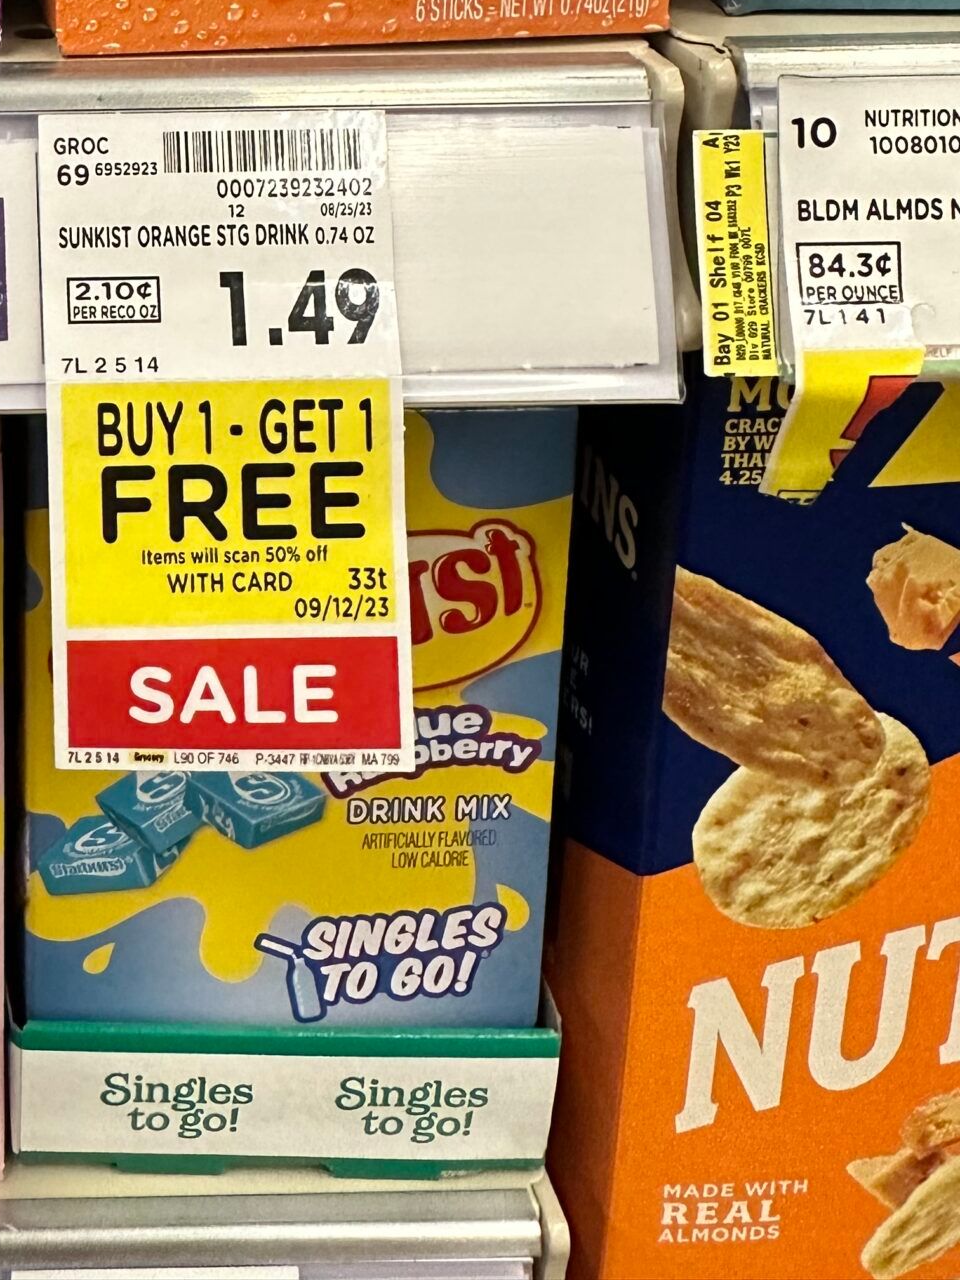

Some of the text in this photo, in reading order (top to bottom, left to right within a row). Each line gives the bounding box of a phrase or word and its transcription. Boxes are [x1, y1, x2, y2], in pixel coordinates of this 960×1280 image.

[791, 117, 837, 148] 10
[54, 137, 109, 155] GROC
[57, 164, 89, 186] 69
[95, 162, 158, 176] 6952923
[216, 178, 372, 198] 0007239232402
[320, 202, 372, 217] 08/25/23
[798, 198, 942, 221] BLDM ALMDS
[58, 223, 375, 249] SUNKIST ORANGE STG DRINK 0.74 OZ
[809, 252, 891, 278] 84.3¢
[74, 282, 152, 301] 2.10¢
[705, 199, 735, 367] Bay 01 Shelf 04
[806, 284, 899, 301] PER OUNCE
[73, 304, 158, 320] PER RECO OZ
[219, 268, 380, 346] 1.49
[101, 461, 366, 544] FREE
[167, 571, 293, 594] WITH CARD
[348, 568, 387, 590] 33t
[294, 596, 389, 621] 09/12/23
[128, 664, 339, 724] SALE
[347, 794, 512, 825] DRINK MIX
[302, 906, 502, 961] SINGLES
[322, 951, 477, 1001] TO GO!
[100, 1073, 253, 1112] Singles
[335, 1077, 489, 1115] Singles
[128, 1107, 240, 1138] to go!
[362, 1111, 474, 1143] to go!
[663, 1179, 809, 1199] MADE WITH
[661, 1199, 781, 1225] REAL
[658, 1226, 780, 1243] ALMONDS
